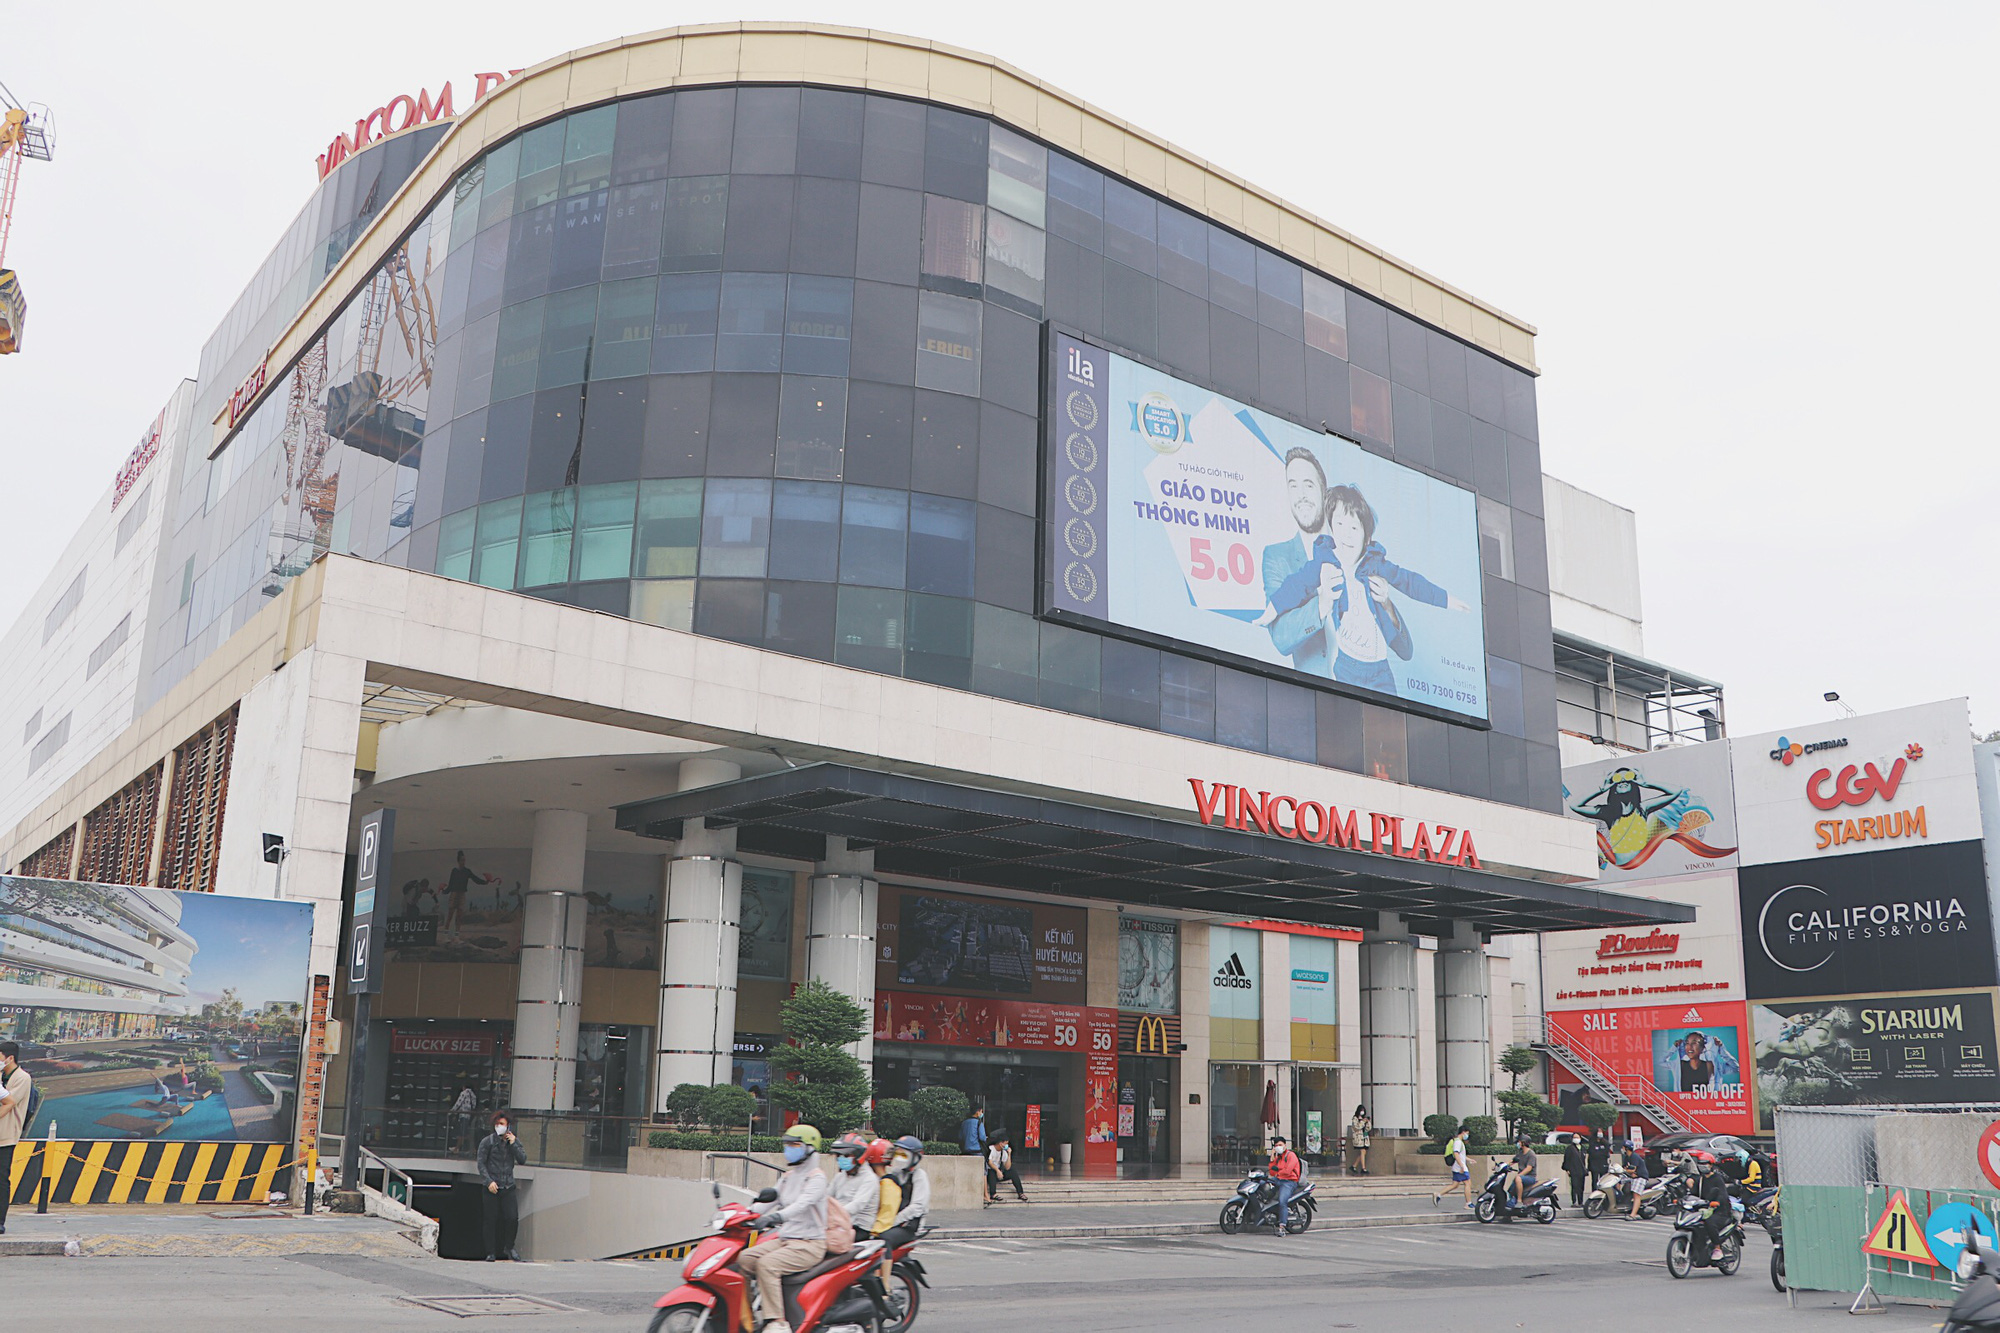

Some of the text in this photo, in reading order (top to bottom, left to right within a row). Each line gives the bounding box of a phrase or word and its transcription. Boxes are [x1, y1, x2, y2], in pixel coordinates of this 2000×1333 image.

[315, 80, 453, 183] VINCOM
[1068, 347, 1094, 380] ila
[1145, 413, 1177, 426] EDUCATION
[1151, 408, 1171, 418] SMART
[1154, 422, 1170, 436] 5.0
[1178, 462, 1189, 472] TỰ
[1190, 464, 1206, 475] HÀO
[1223, 470, 1244, 482] THIỆU
[1160, 478, 1248, 512] GIÁO DỤC
[1134, 500, 1250, 535] THÔNG MINH
[1190, 536, 1255, 586] 5.0
[1441, 656, 1476, 672] ila.edu.vn
[1406, 677, 1478, 705] (028) 7300 6758
[1453, 678, 1477, 691] hotline
[1804, 738, 1848, 754] CINEMAS
[1806, 757, 1907, 810] CGV
[1186, 777, 1483, 870] VINCOM PLAZA
[1814, 805, 1928, 849] STARIUM
[363, 830, 374, 872] P
[1684, 862, 1715, 871] VINCOM
[1788, 898, 1966, 932] CALIFORNIA
[404, 921, 430, 932] BUZZ
[1142, 922, 1176, 933] TISSOT
[1060, 929, 1074, 945] NỐI
[1036, 947, 1083, 966] HUYẾT MẠCH
[1213, 976, 1252, 990] adidas
[1296, 972, 1324, 980] watsons
[1582, 1010, 1660, 1032] SALE SALE
[1860, 1004, 1964, 1034] STARIUM
[1584, 1034, 1652, 1054] SALE SAL
[1910, 1032, 1944, 1040] LASER
[404, 1039, 481, 1052] LUCKY SIZE
[734, 1044, 755, 1052] ERSE
[1626, 1058, 1653, 1076] SAL
[1692, 1084, 1719, 1100] 50%
[1721, 1083, 1744, 1099] OFF
